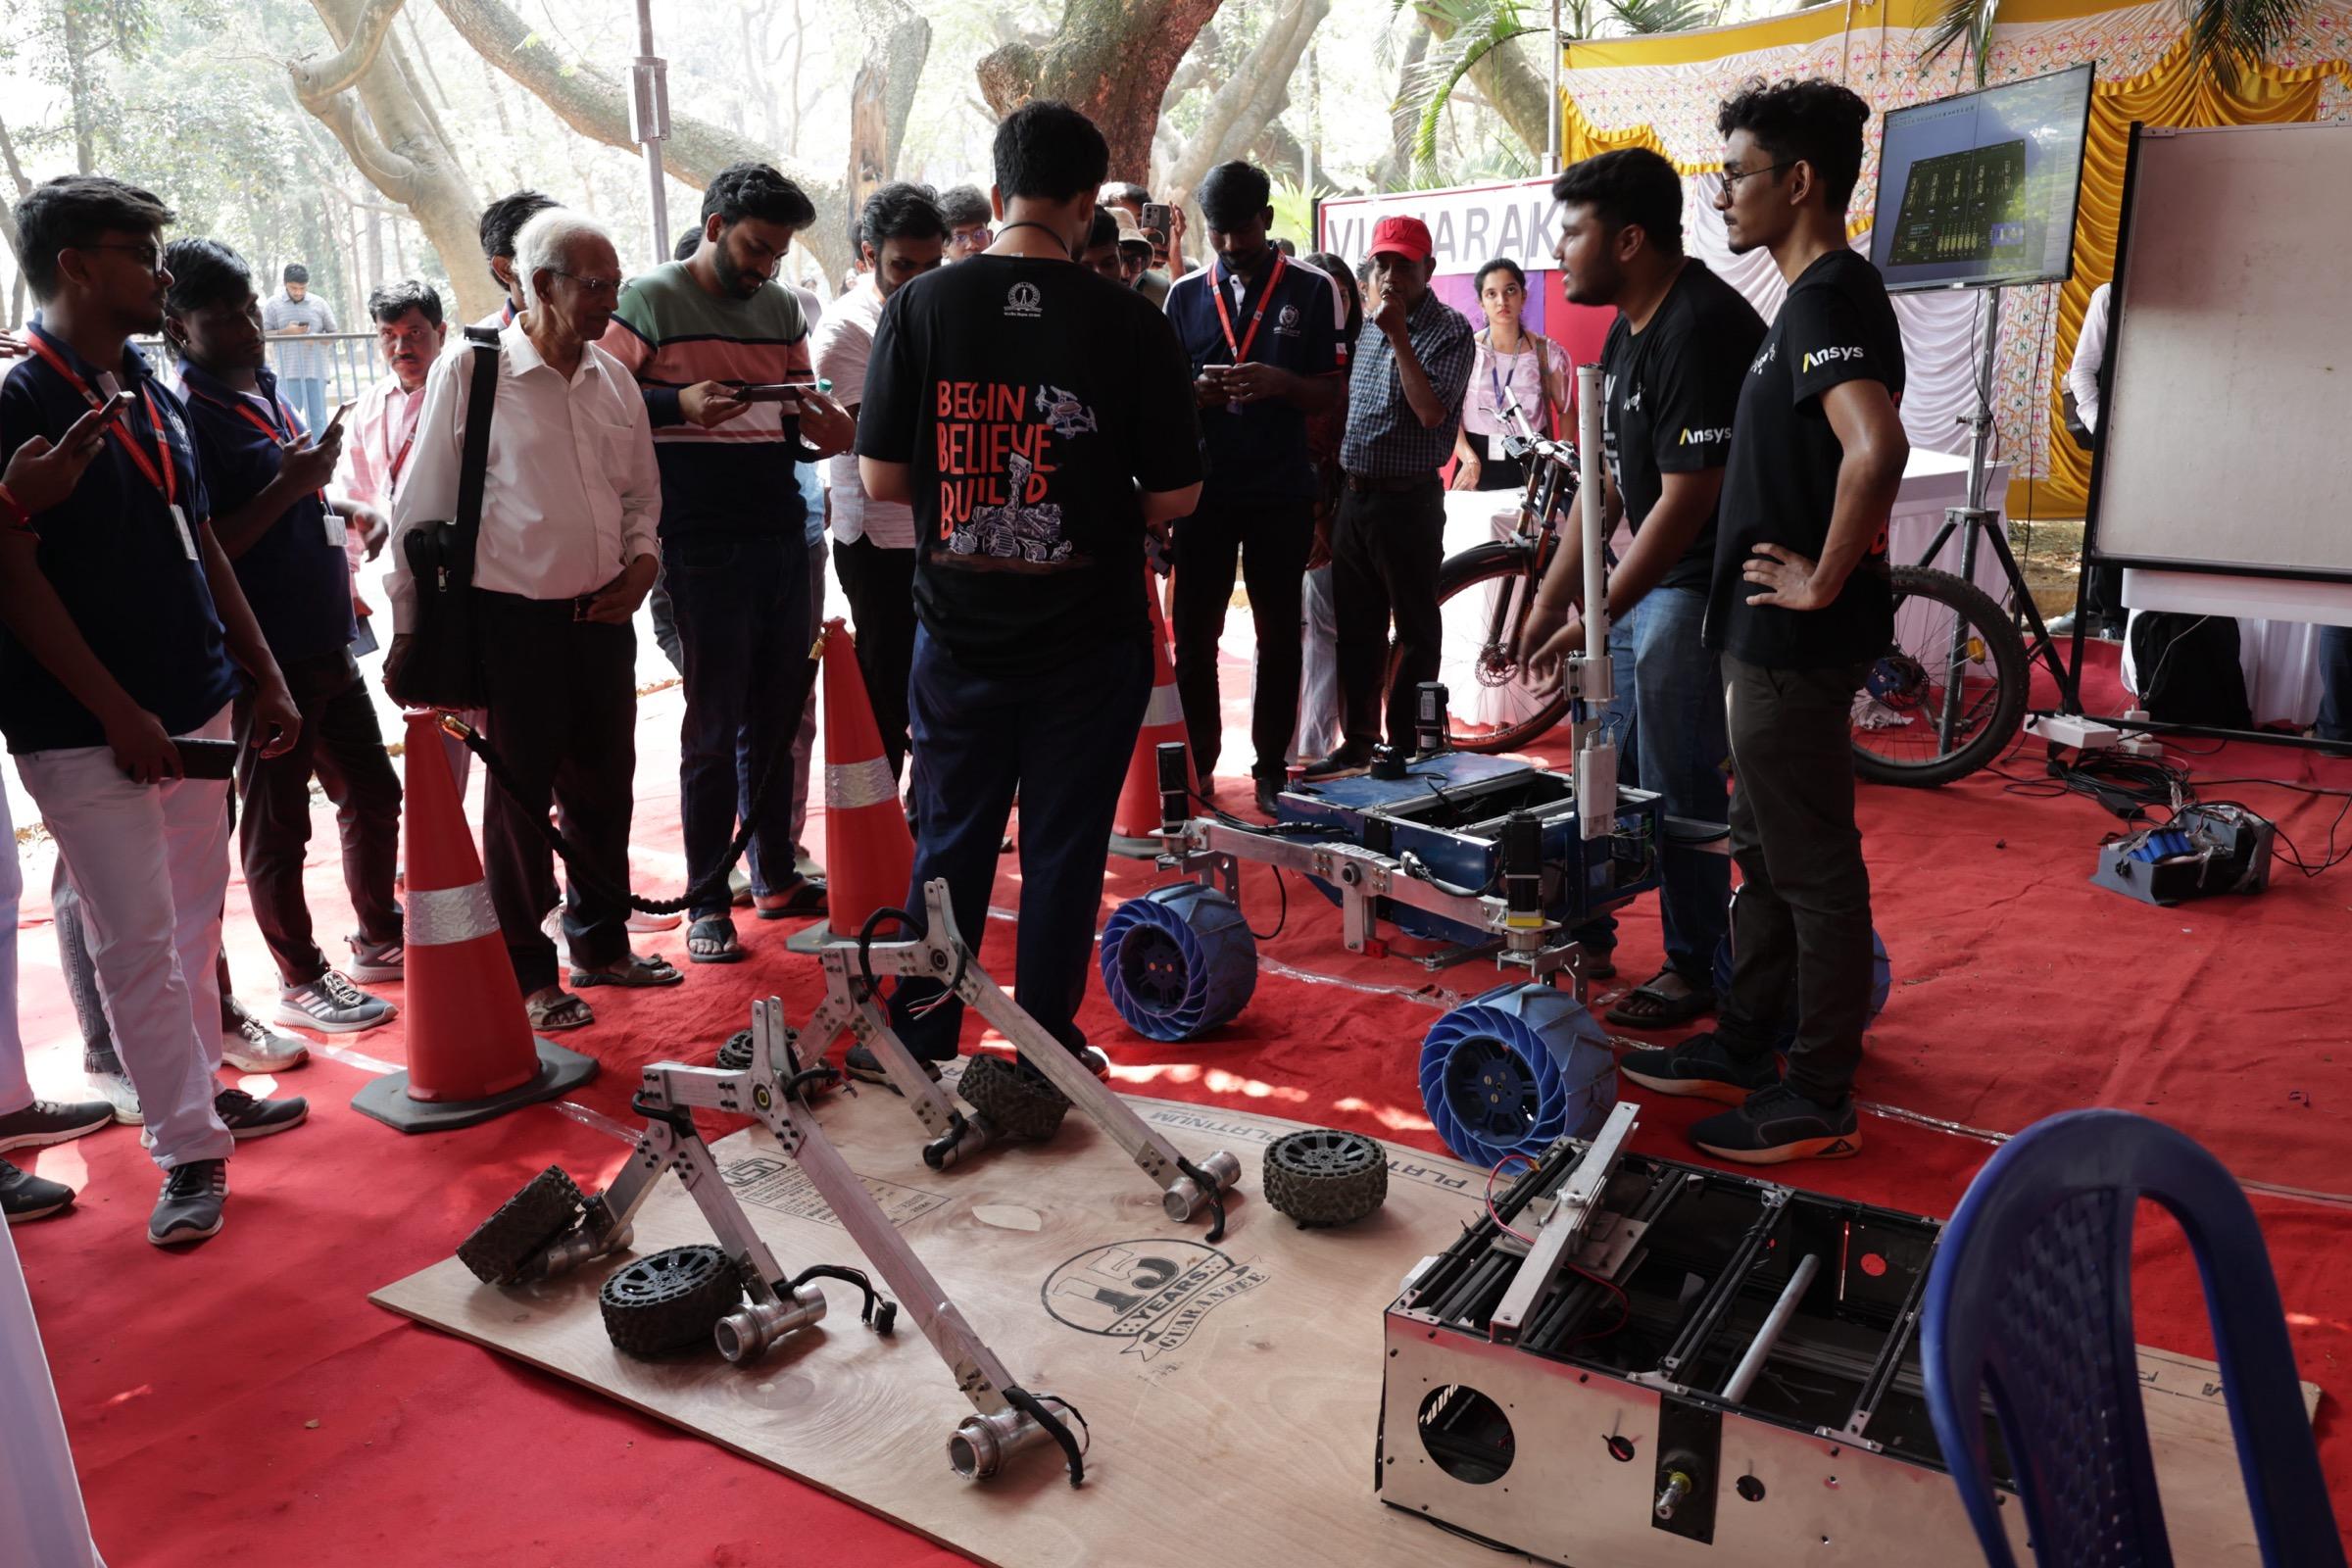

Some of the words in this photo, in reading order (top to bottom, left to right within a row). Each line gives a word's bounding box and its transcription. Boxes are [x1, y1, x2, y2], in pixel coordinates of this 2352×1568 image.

[1328, 201, 1560, 264] VIARAK
[1803, 346, 1864, 373] Ansys
[937, 380, 1026, 421] BEGIN
[936, 422, 1057, 475] BELIEVE
[1679, 426, 1732, 446] Ansys
[940, 472, 1049, 541] BUILD
[1053, 1247, 1179, 1315] 15
[1130, 1271, 1209, 1320] YEARS
[1158, 1272, 1265, 1348] GUARANTEE
